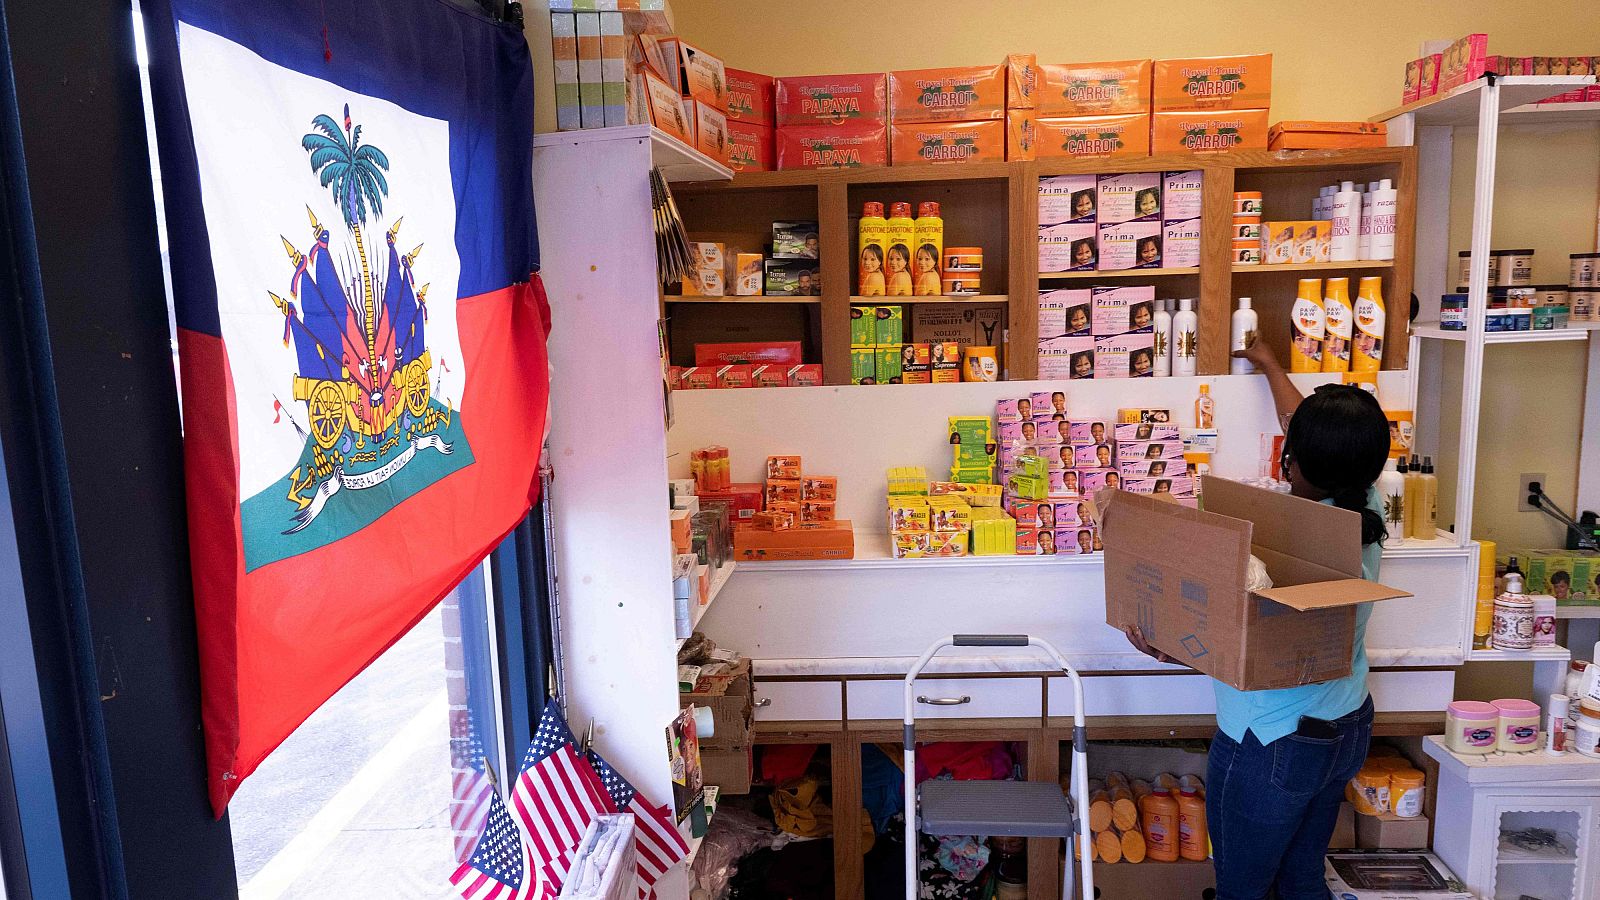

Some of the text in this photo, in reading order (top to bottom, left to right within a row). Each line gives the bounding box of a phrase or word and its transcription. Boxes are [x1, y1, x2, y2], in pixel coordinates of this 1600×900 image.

[1181, 65, 1247, 78] Royal Touch
[729, 78, 756, 91] Touch
[915, 76, 979, 89] Royal Touch
[1189, 80, 1239, 96] CARROT
[800, 83, 862, 95] Royal Touch
[1069, 85, 1120, 101] CARROT
[727, 92, 753, 109] AYA
[802, 97, 860, 113] PAPAYA
[923, 91, 974, 108] CARROT
[1060, 125, 1124, 137] Royal Touch
[1179, 120, 1244, 131] Royal Touch
[733, 130, 759, 143] Touch
[800, 136, 862, 147] Royal Touch
[916, 130, 980, 142] Royal Touch
[1186, 134, 1236, 149] CARROT
[924, 143, 975, 160] CARROT
[1068, 138, 1119, 154] CARROT
[803, 149, 860, 165] PAPAYA
[1038, 183, 1069, 194] Prima
[1102, 183, 1133, 193] Prima
[1169, 179, 1201, 189] Prima
[1038, 232, 1069, 242] Prima
[1104, 230, 1134, 240] Prima
[1168, 228, 1200, 238] Prima
[1334, 227, 1350, 236] TION
[1038, 298, 1064, 308] rima
[1097, 295, 1127, 306] Prima
[1038, 344, 1068, 355] Prima
[1097, 341, 1127, 353] Prima
[717, 352, 747, 362] Royal
